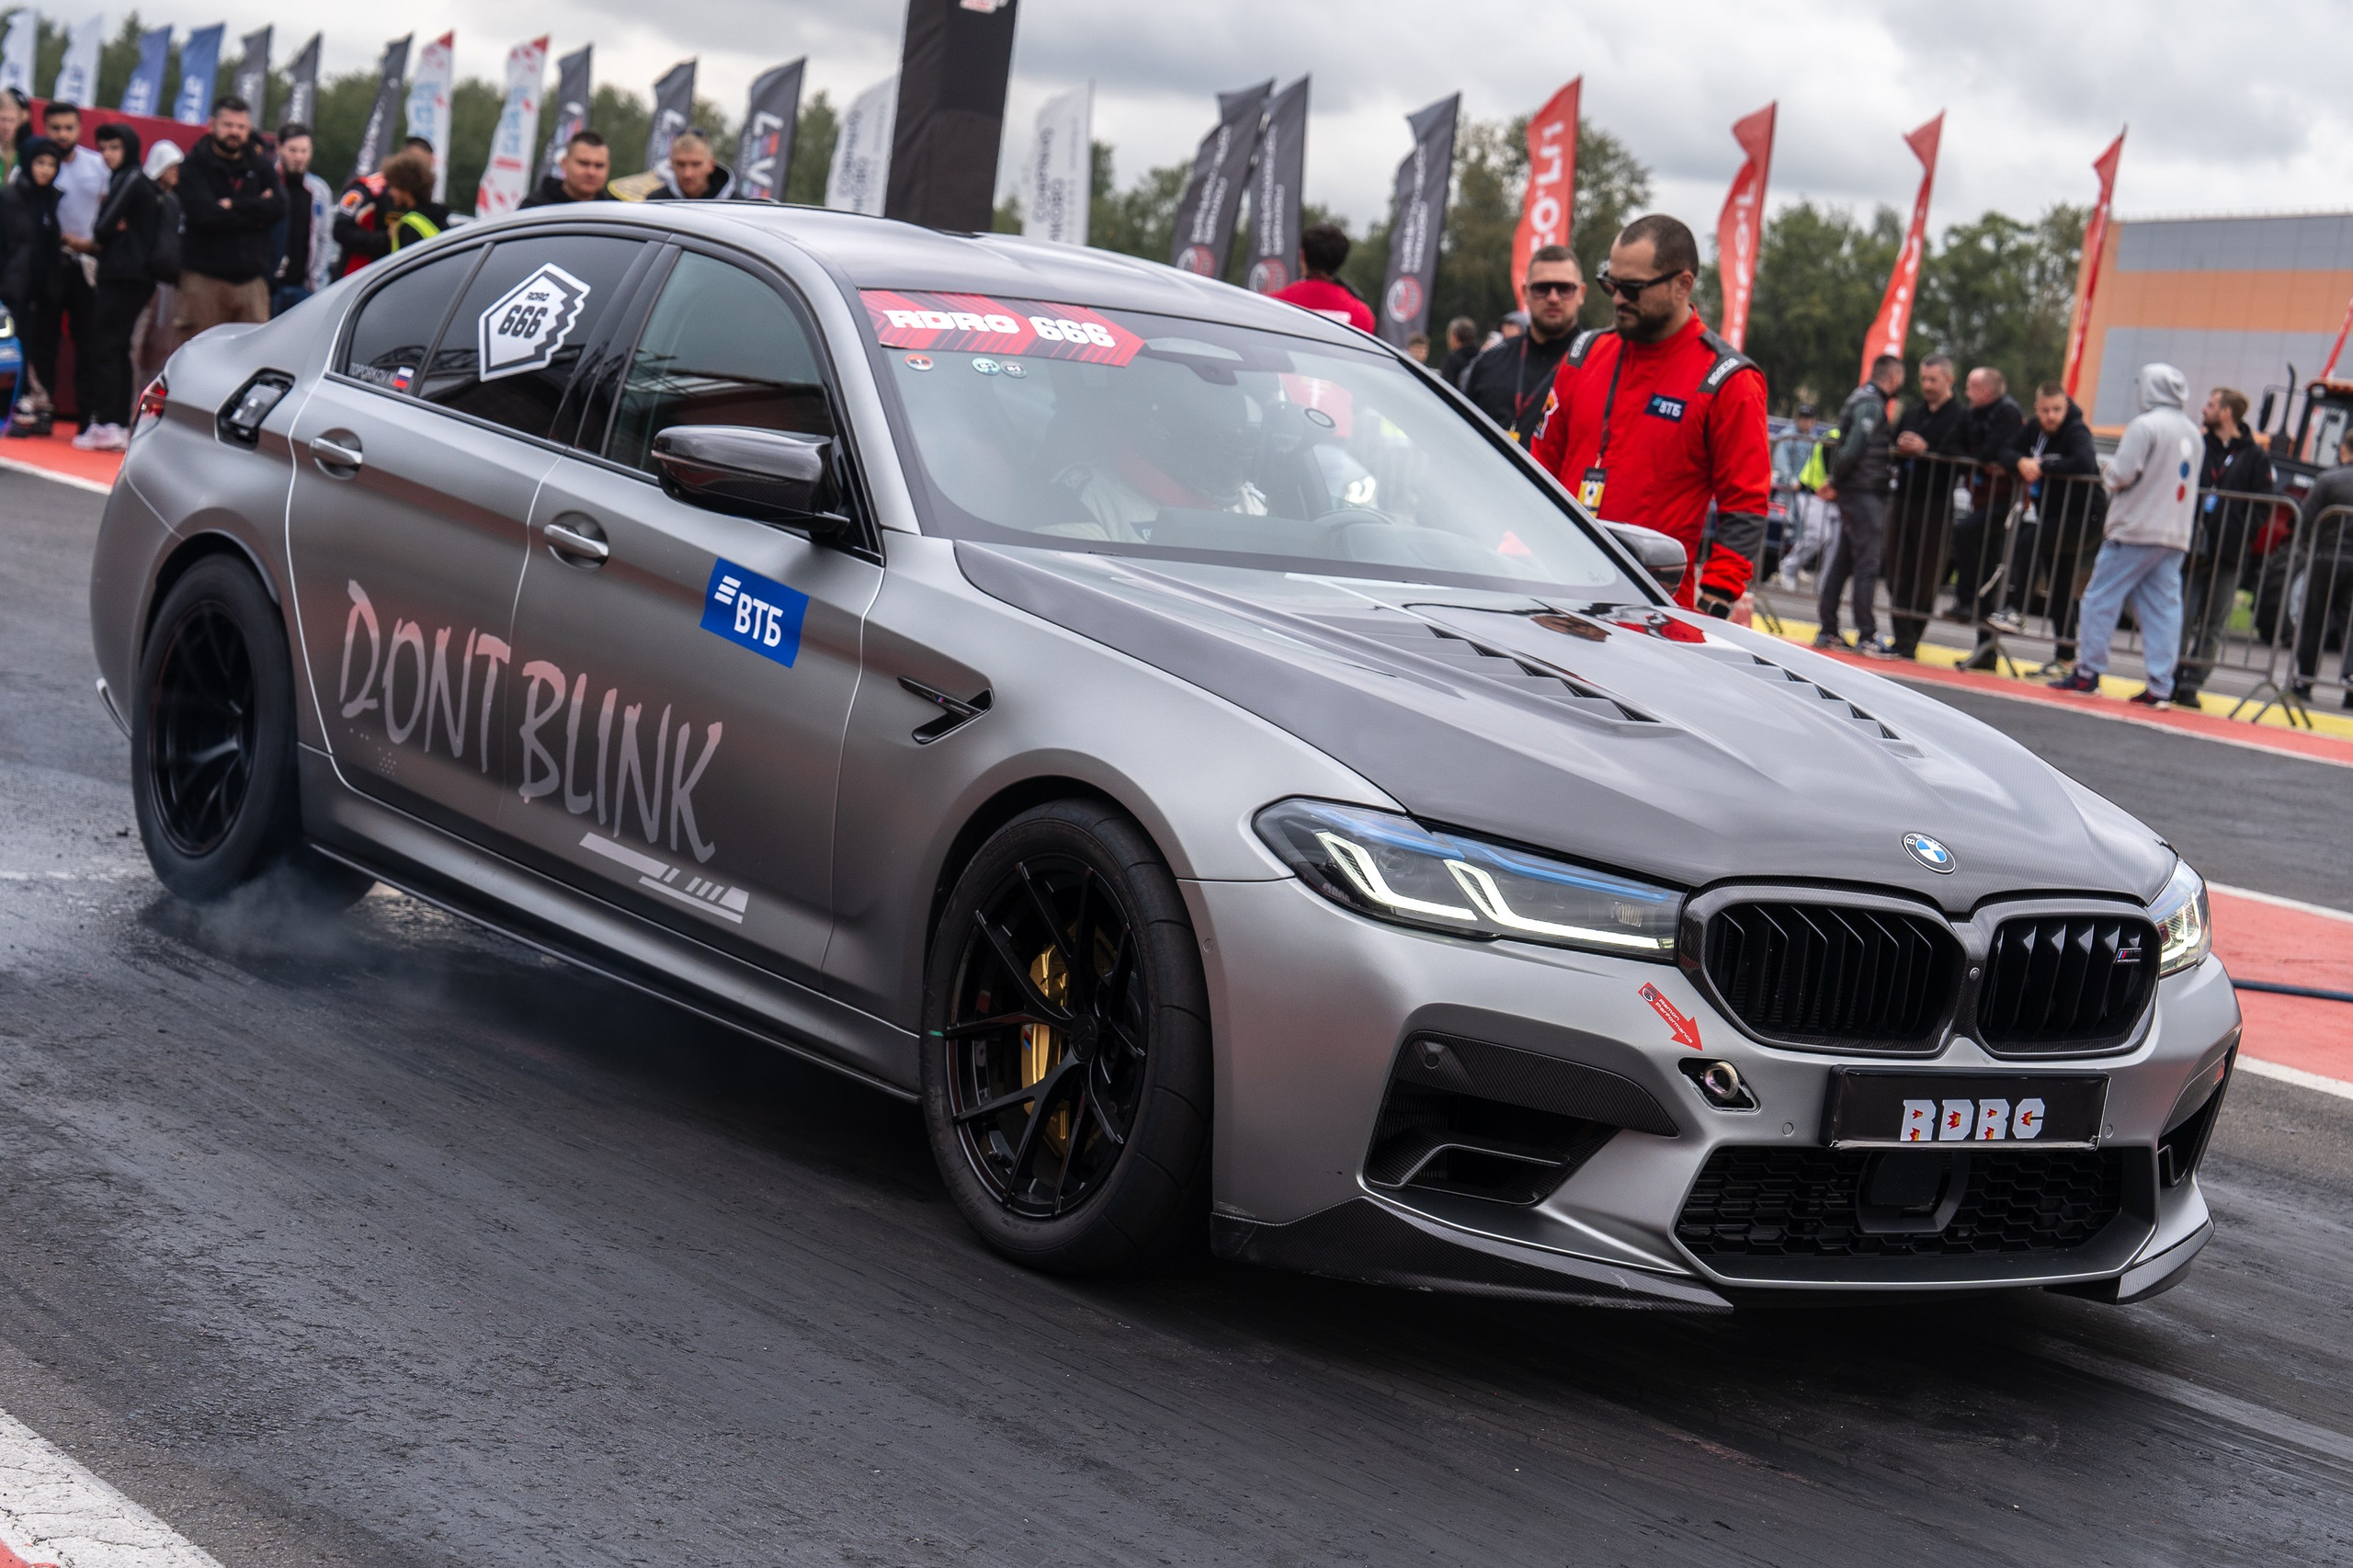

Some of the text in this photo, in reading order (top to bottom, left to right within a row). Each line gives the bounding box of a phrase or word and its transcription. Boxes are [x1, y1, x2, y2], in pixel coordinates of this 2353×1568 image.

[497, 304, 549, 339] 666
[1028, 316, 1116, 347] 666
[733, 592, 784, 648] ВТБ
[339, 579, 722, 864] DONT BLINK
[1654, 1002, 1693, 1044] Performance
[1659, 998, 1680, 1021] Ramon
[1900, 1098, 2046, 1142] RDRC
